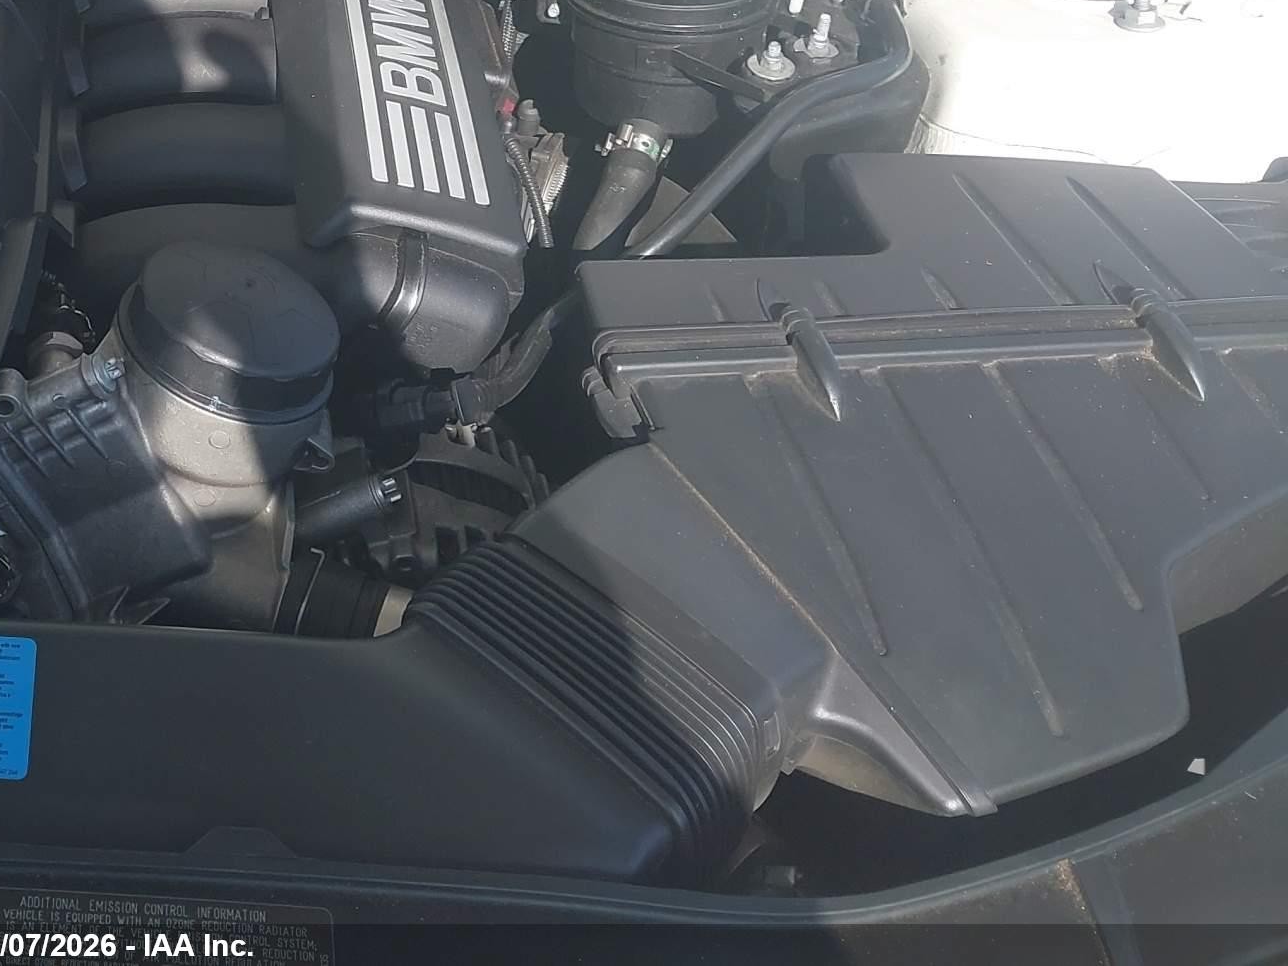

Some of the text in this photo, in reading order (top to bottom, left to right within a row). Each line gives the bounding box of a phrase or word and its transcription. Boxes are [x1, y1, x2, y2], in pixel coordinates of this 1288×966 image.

[3, 908, 43, 922] VEHICLE
[51, 911, 61, 922] IS
[65, 911, 112, 925] EQUIPPED
[117, 914, 143, 926] WITH
[147, 918, 162, 928] AN
[166, 919, 196, 931] OZONE
[201, 920, 254, 934] REDUCTION
[259, 924, 308, 938] RADIATOR
[20, 896, 267, 923] ADDITIONAL EMISSION CONTROL INFORMATION
